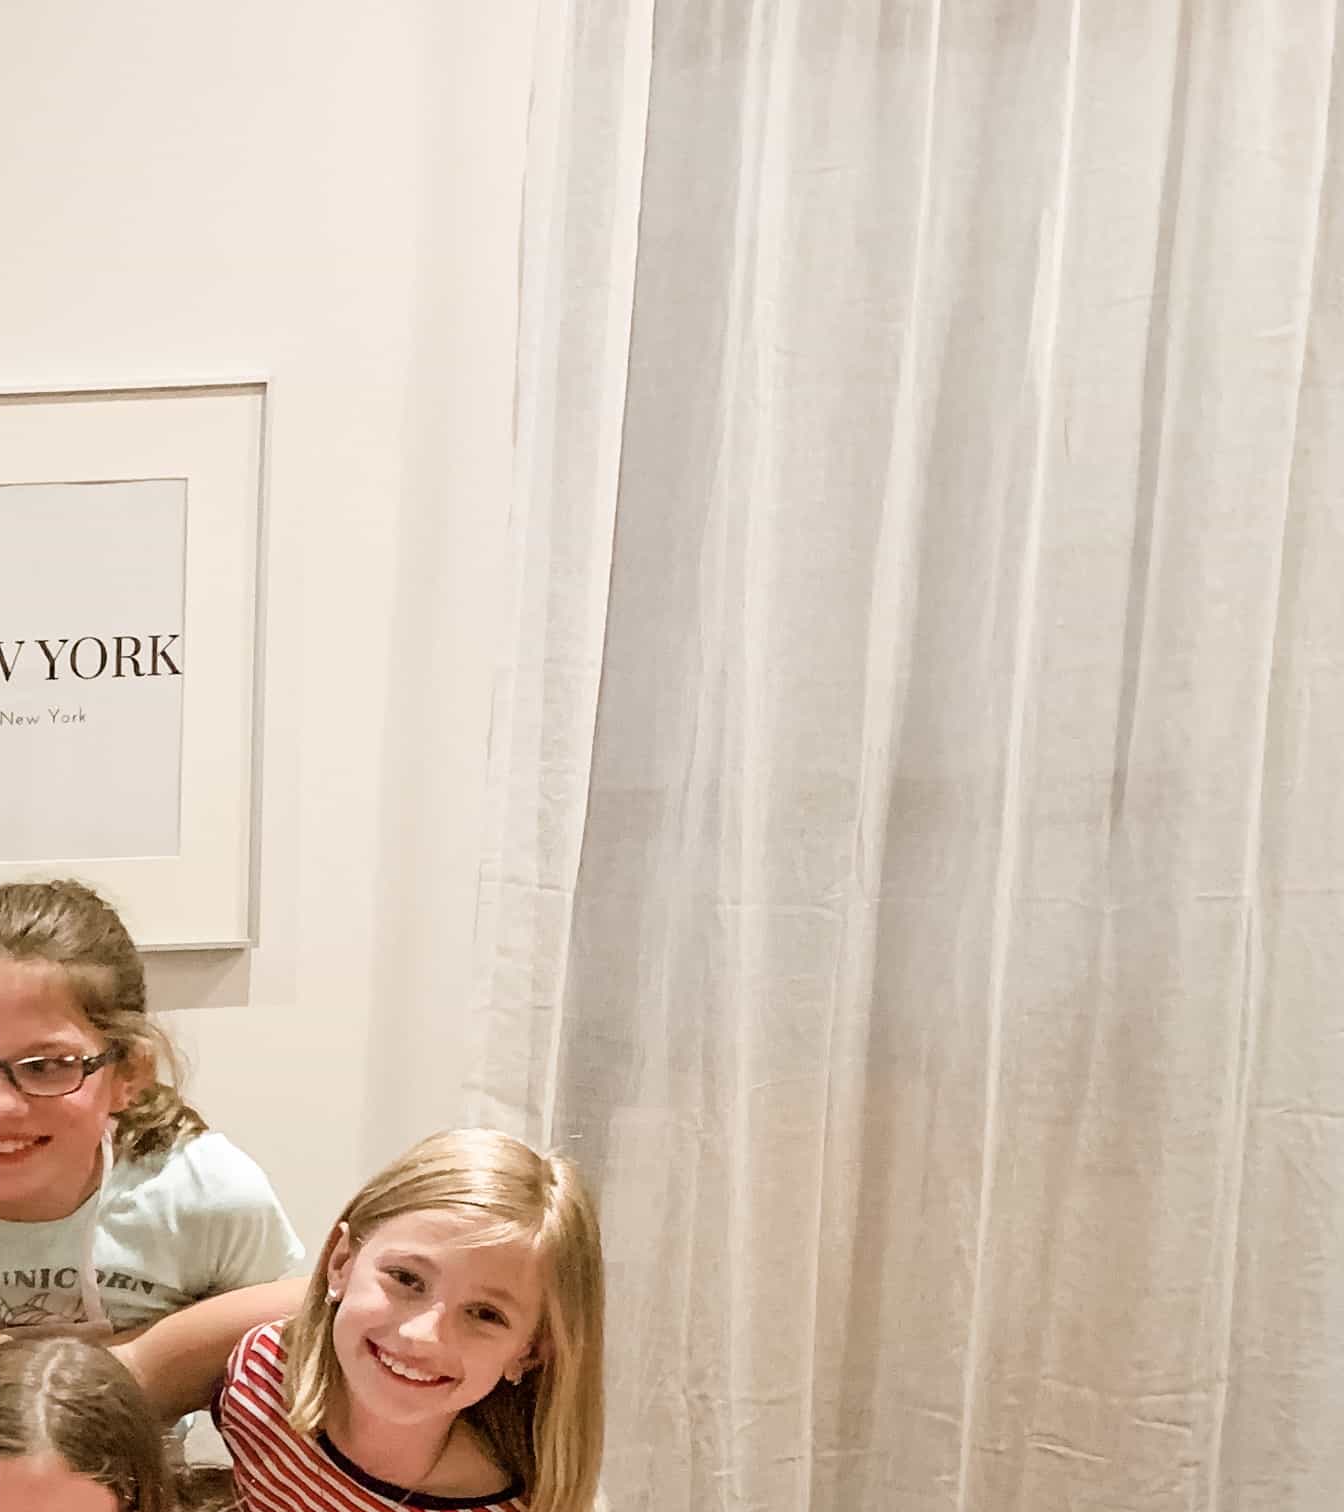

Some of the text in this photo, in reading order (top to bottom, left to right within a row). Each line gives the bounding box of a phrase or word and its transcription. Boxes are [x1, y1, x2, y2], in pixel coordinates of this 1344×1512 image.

[34, 634, 183, 680] YORK
[0, 707, 87, 726] New York
